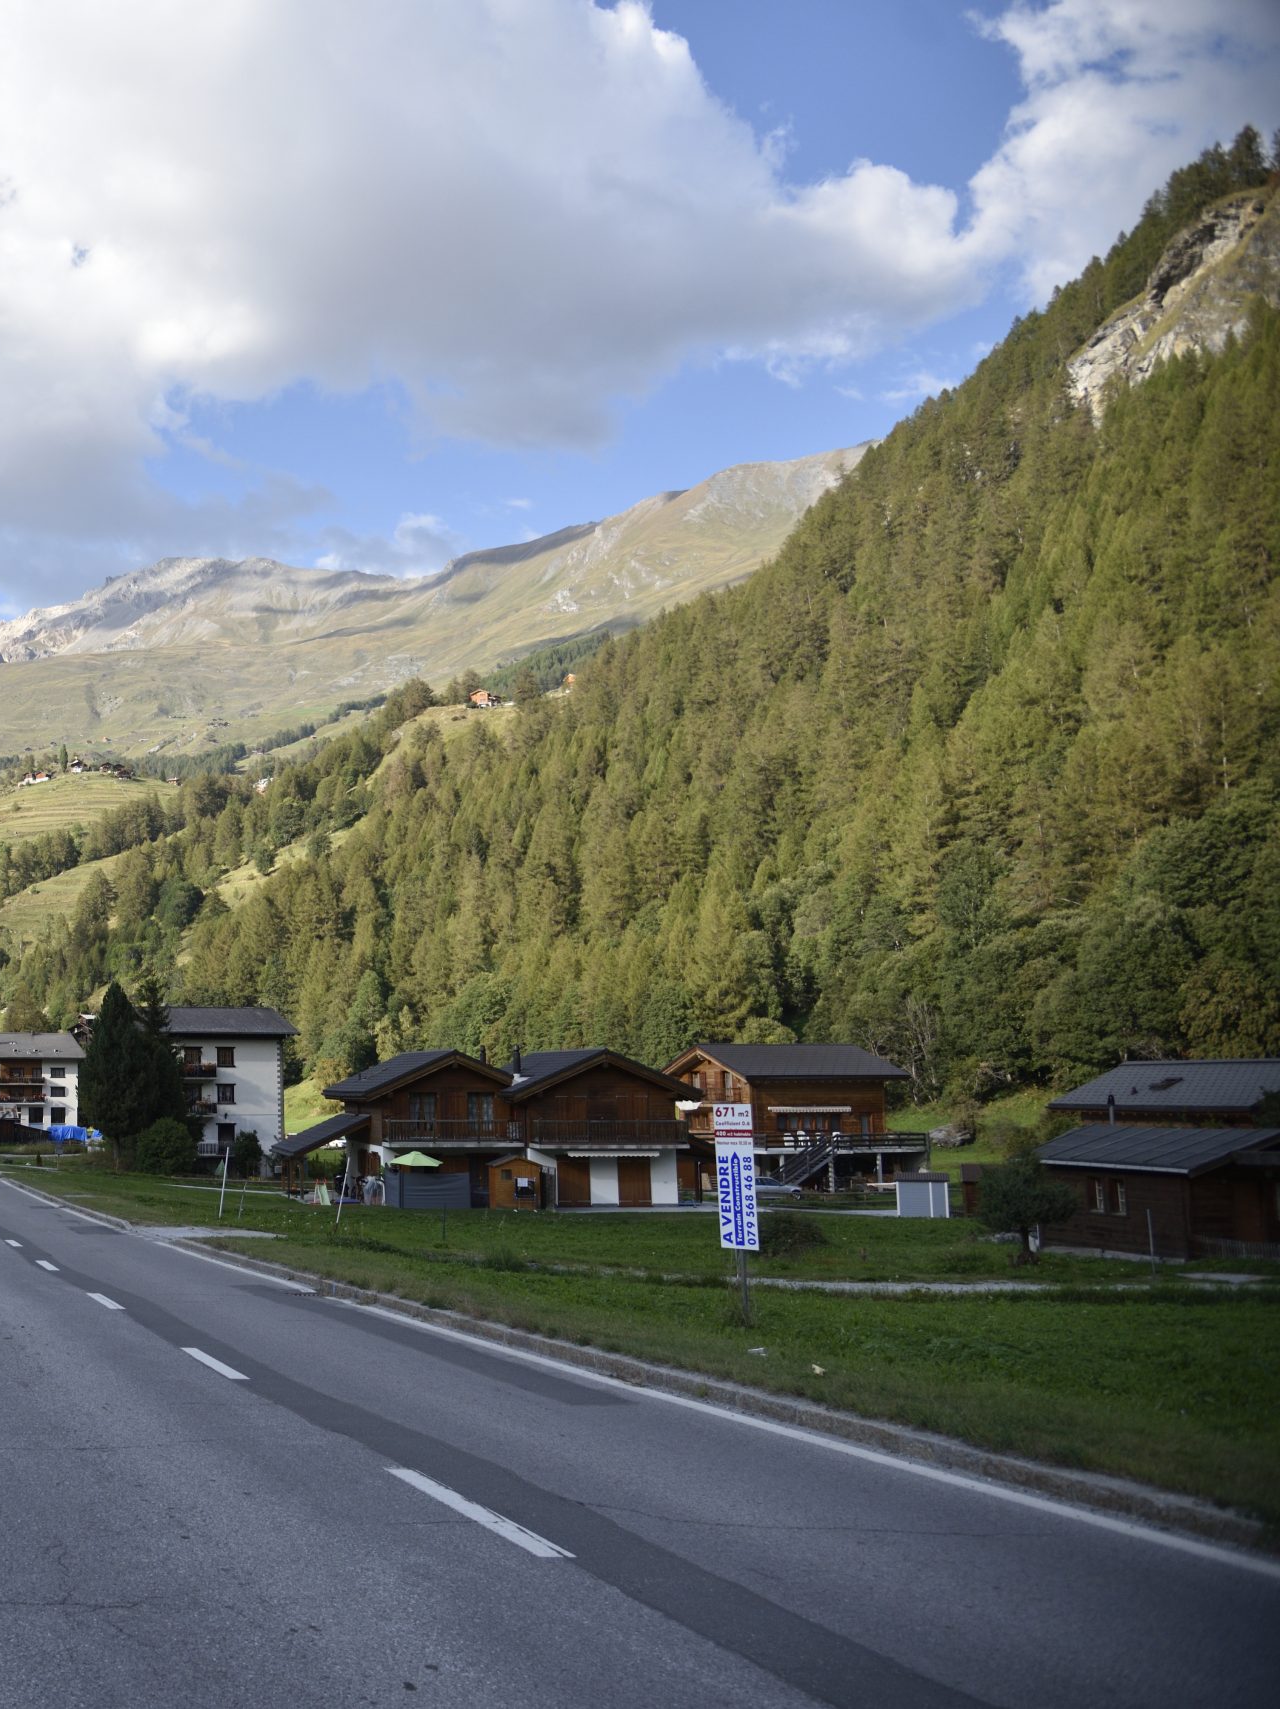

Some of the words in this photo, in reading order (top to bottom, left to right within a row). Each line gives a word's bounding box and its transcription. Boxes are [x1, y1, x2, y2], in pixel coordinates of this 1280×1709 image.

[715, 1107, 735, 1117] 671
[742, 1156, 752, 1171] 88
[718, 1155, 732, 1227] VENDRE
[732, 1158, 741, 1211] Constructible
[743, 1175, 753, 1191] 46
[744, 1194, 755, 1218] 568
[722, 1231, 734, 1244] A
[735, 1213, 743, 1242] Terrain
[746, 1221, 757, 1245] 079
